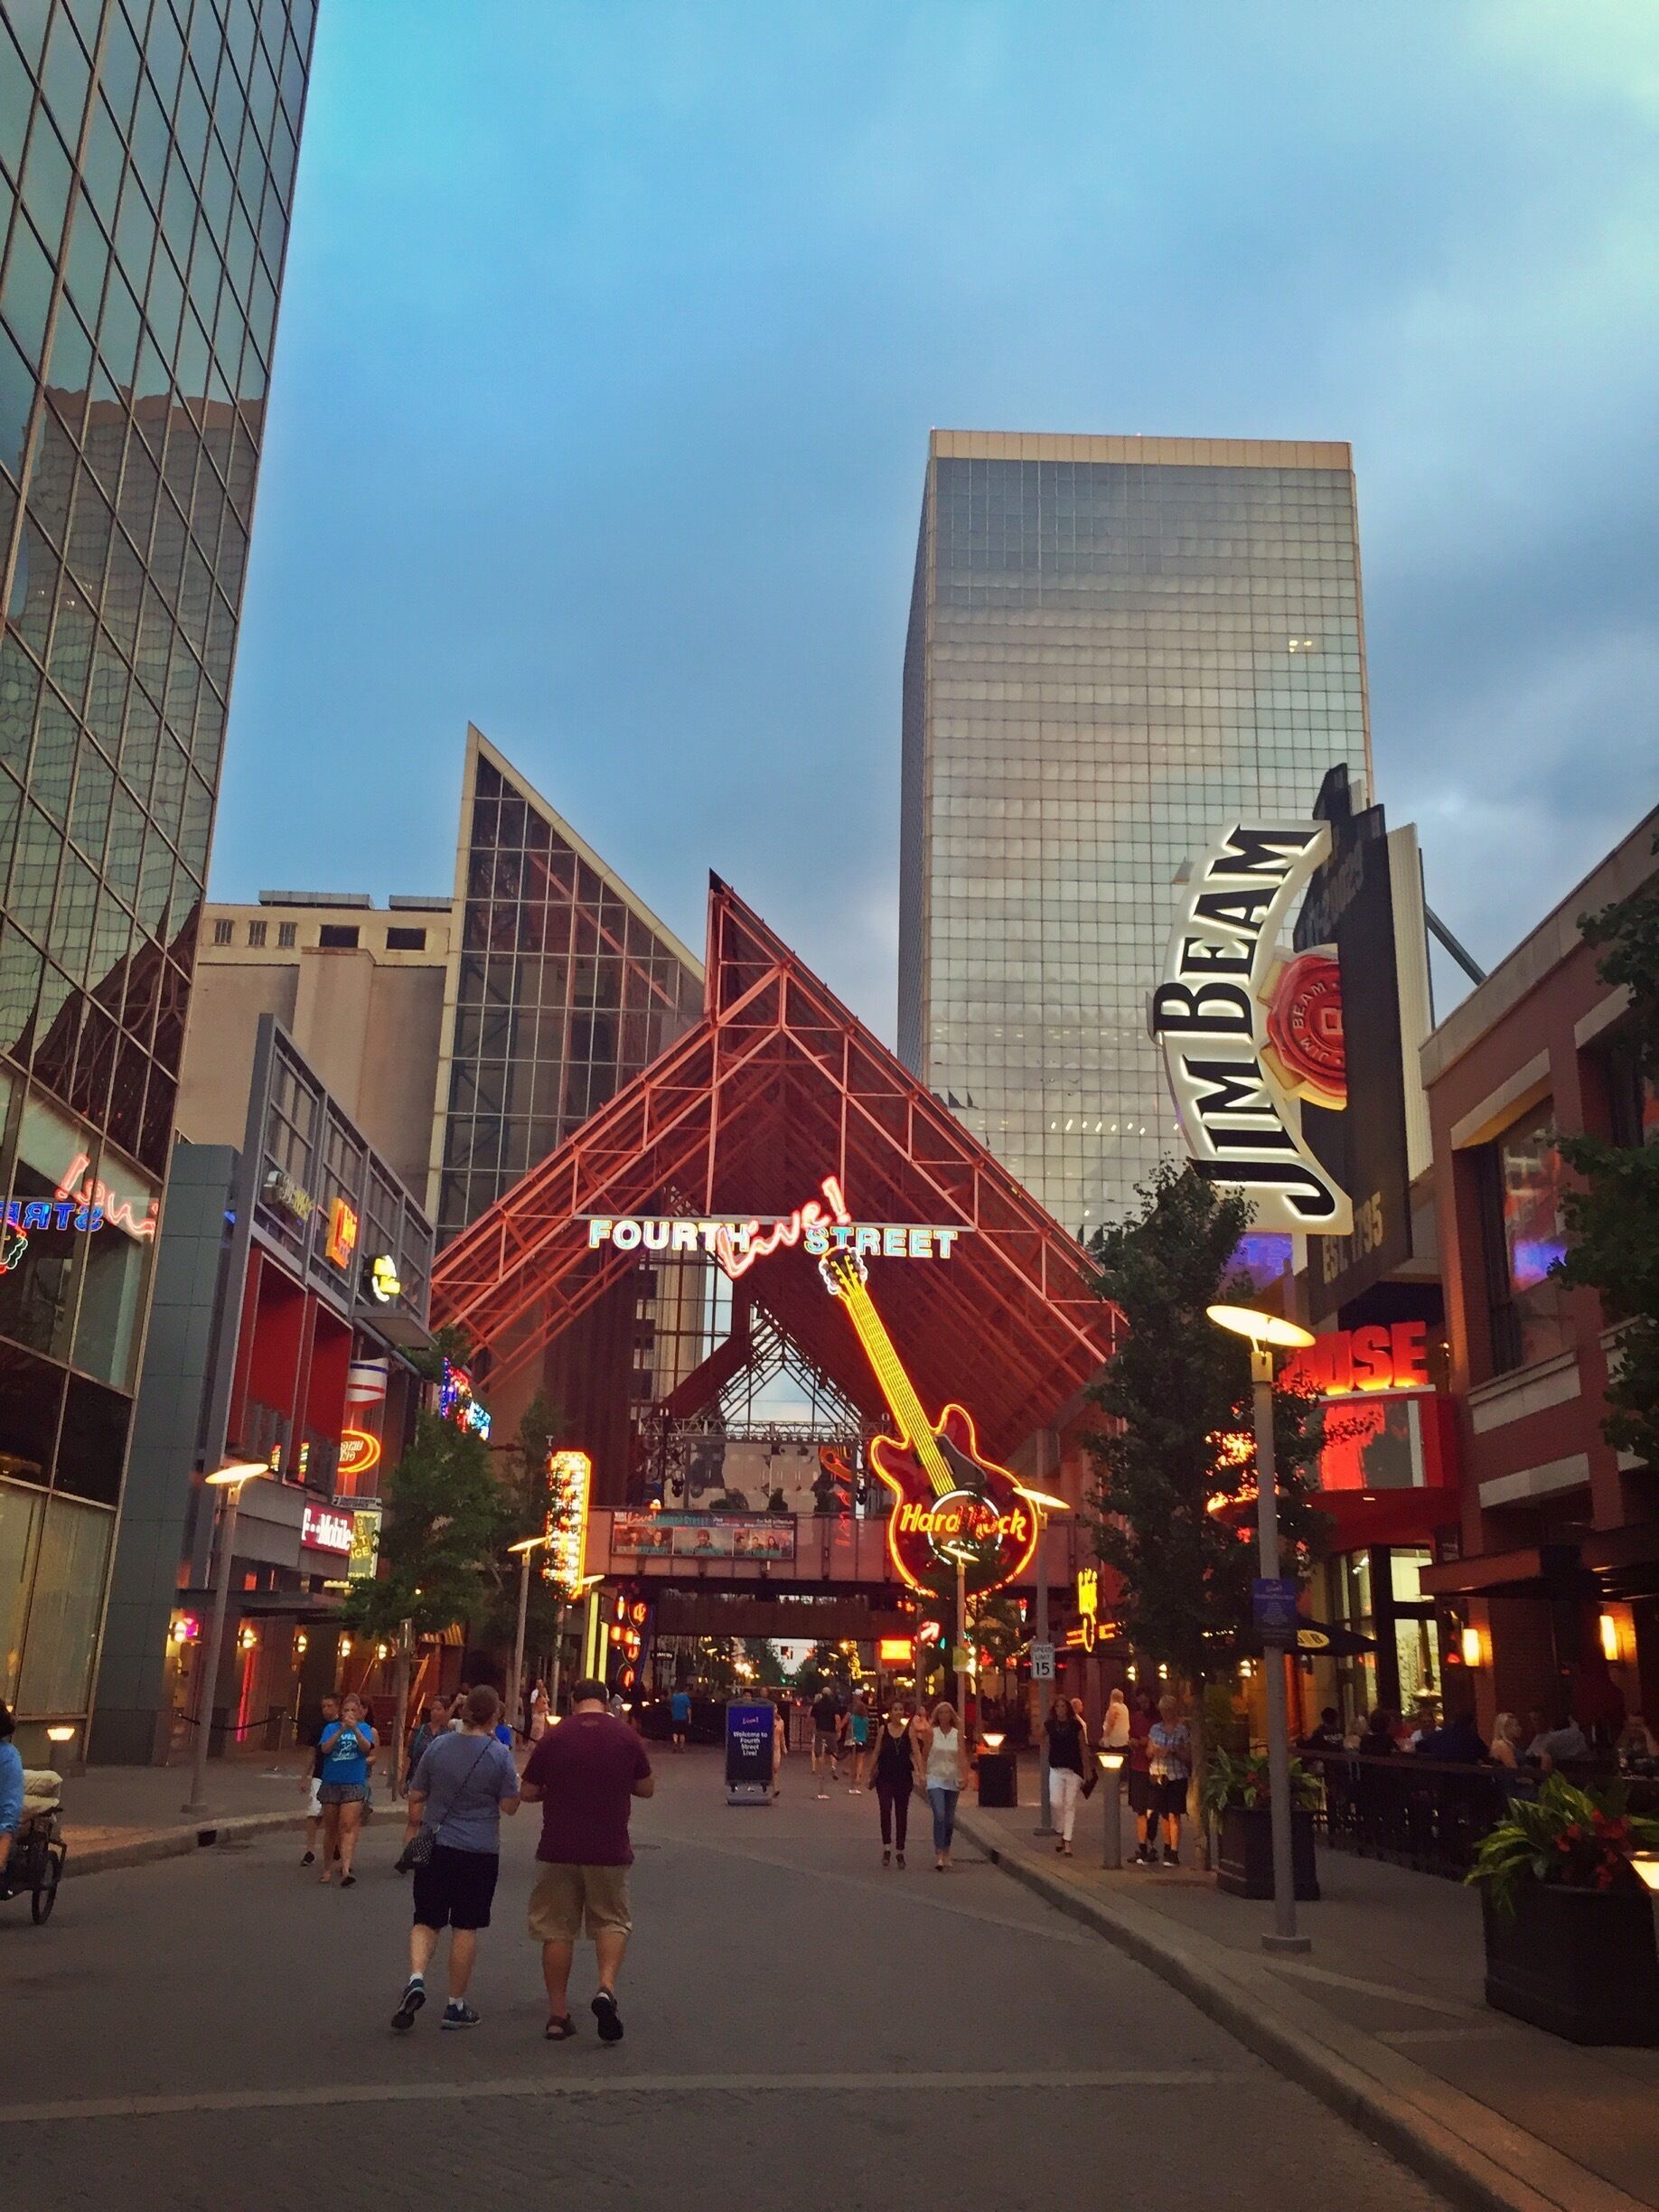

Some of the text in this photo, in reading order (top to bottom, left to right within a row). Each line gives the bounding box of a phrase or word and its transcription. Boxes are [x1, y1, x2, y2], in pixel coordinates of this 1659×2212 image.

[1153, 823, 1336, 1217] JIM BEAM
[1292, 981, 1330, 1063] JIM BEAM
[588, 1218, 959, 1260] FOURTH STREET
[717, 1175, 851, 1279] Live!
[899, 1503, 961, 1533] Hard
[1036, 1662, 1050, 1676] 15
